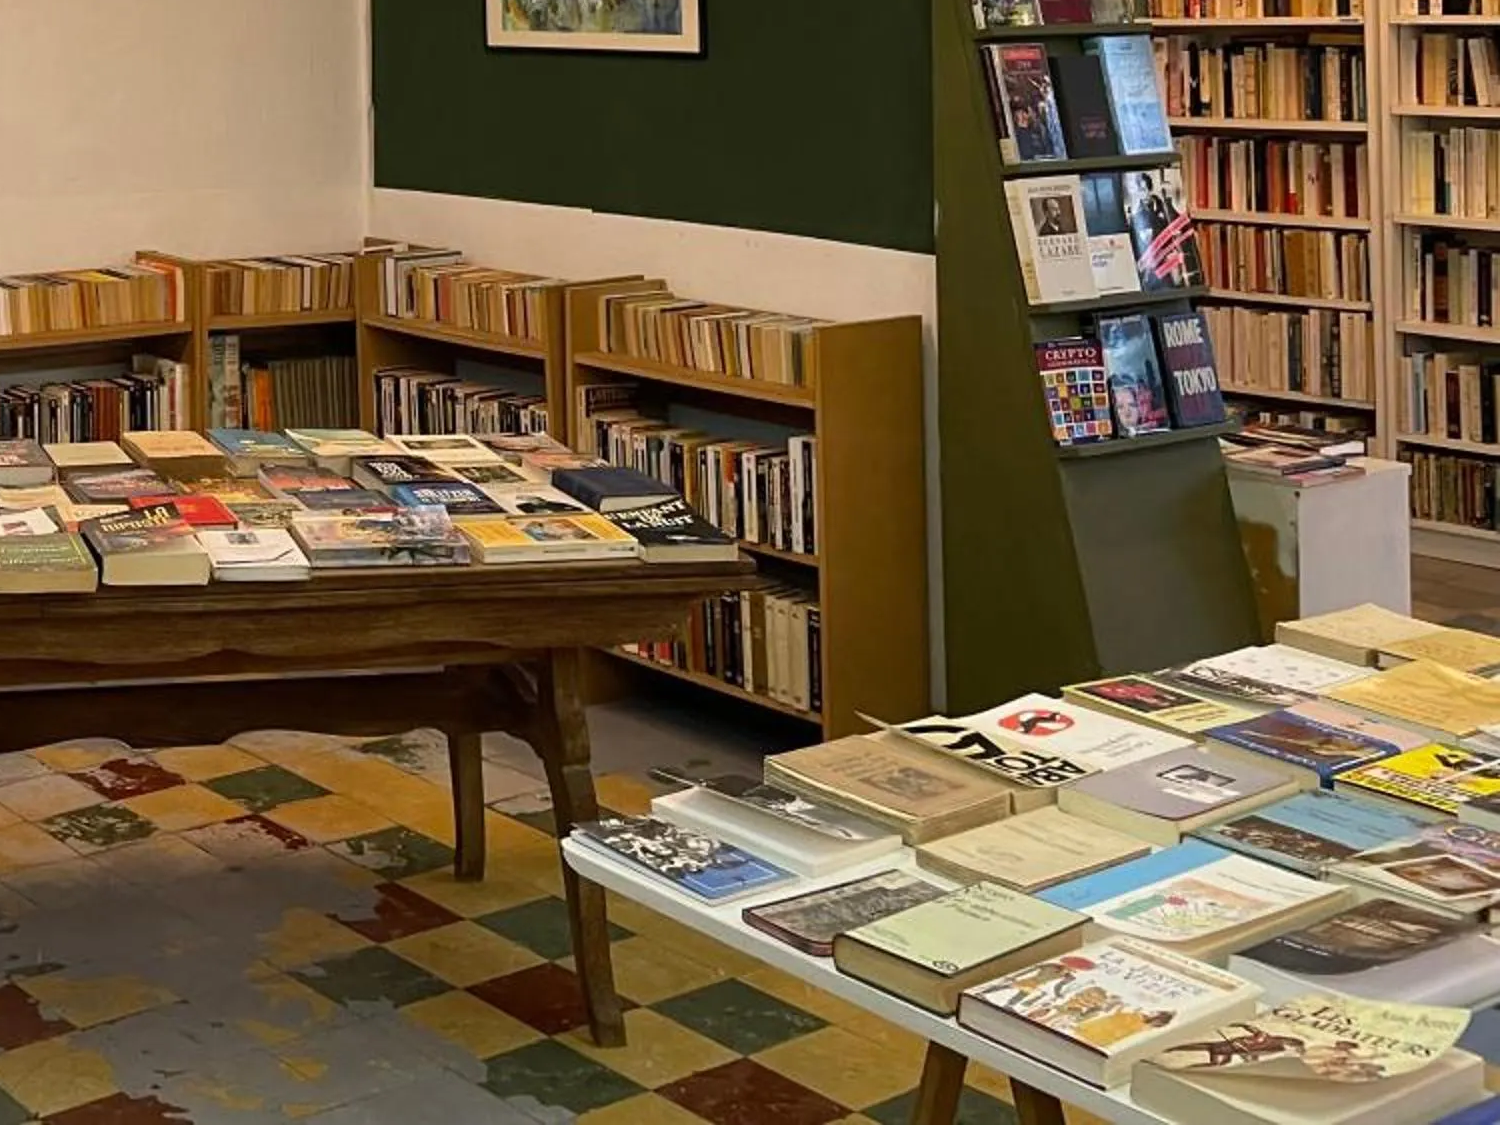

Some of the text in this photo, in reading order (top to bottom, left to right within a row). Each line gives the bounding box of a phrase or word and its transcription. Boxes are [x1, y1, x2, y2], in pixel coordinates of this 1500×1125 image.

[1163, 318, 1204, 348] ROME
[1044, 348, 1097, 362] CRYPTO
[1173, 366, 1217, 396] TOKYO
